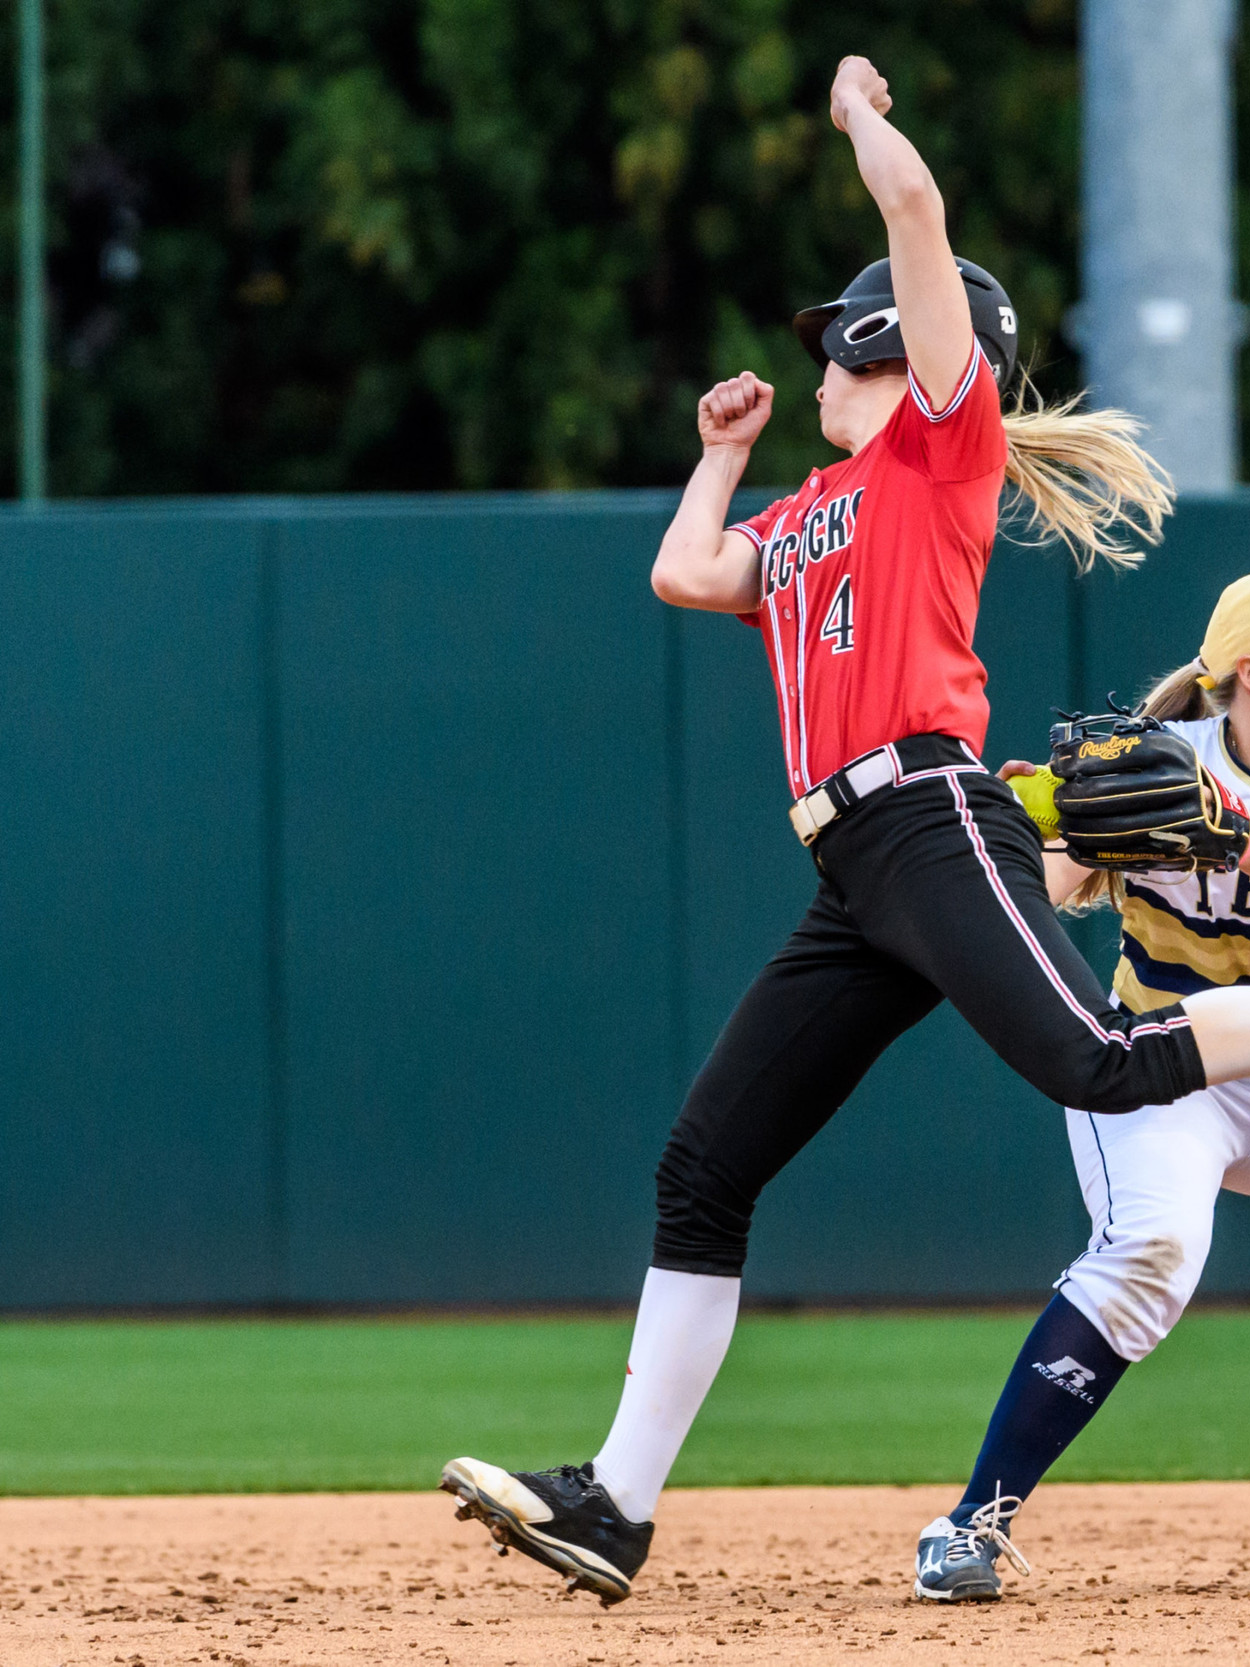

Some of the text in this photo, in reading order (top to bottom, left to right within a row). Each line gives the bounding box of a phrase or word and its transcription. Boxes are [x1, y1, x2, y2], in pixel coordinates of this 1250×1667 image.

[819, 573, 855, 655] 4
[1079, 735, 1142, 760] Rawlings
[1031, 1361, 1095, 1405] RUSSELL
